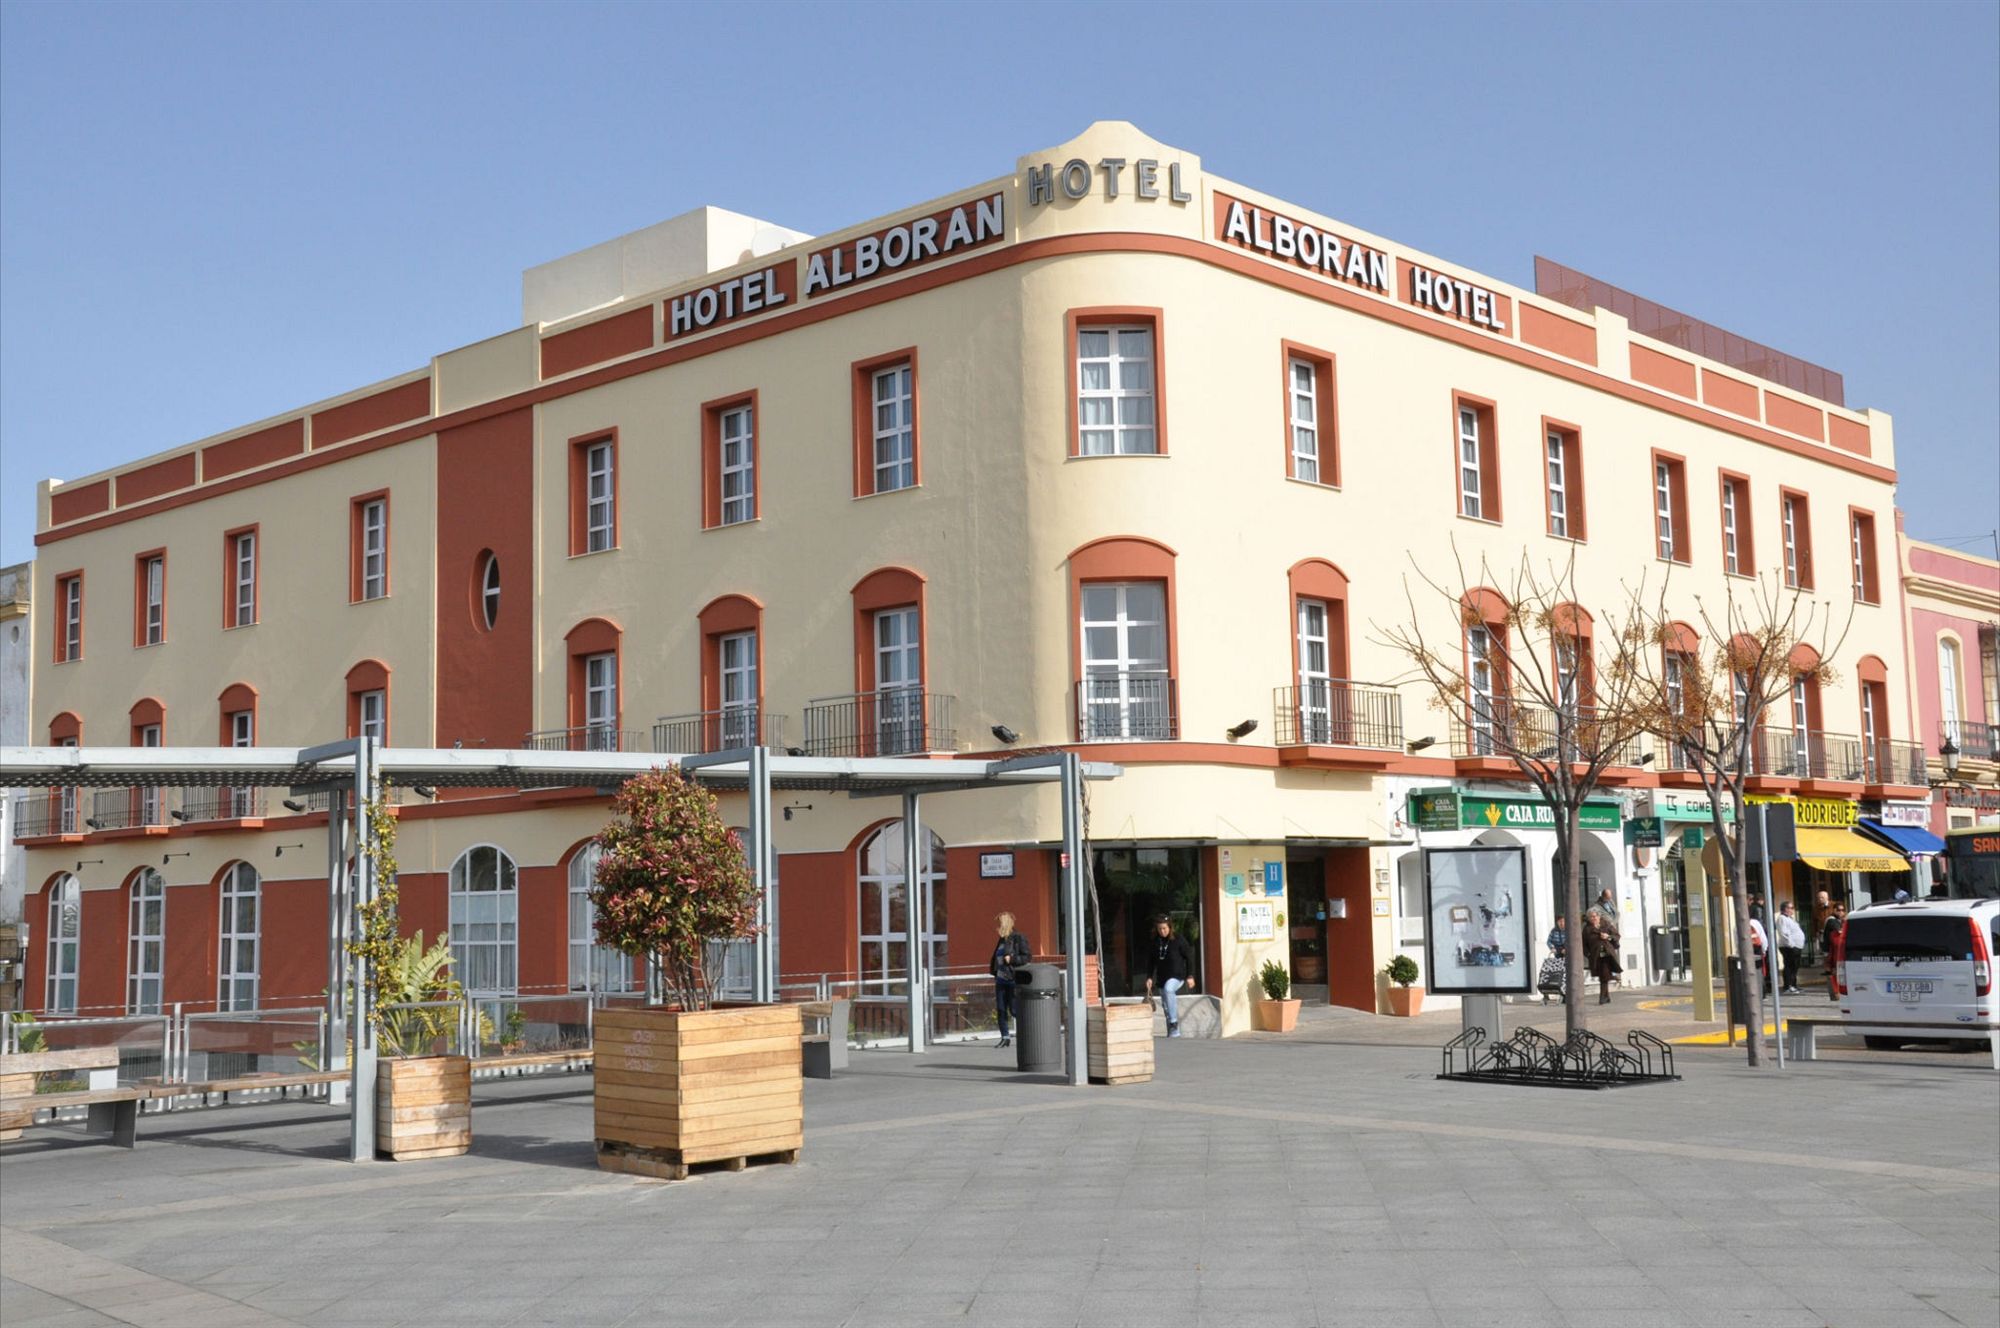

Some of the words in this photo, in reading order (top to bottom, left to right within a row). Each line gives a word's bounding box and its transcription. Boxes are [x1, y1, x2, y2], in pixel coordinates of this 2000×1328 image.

[1028, 158, 1192, 206] HOTEL
[671, 268, 785, 335] HOTEL
[805, 195, 1004, 294] ALBORAN
[1226, 201, 1389, 290] ALBORAN
[1412, 266, 1505, 330] HOTEL
[1505, 805, 1534, 823] CAJA
[1686, 800, 1731, 813] COMESA
[1797, 803, 1858, 824] RODRIGUEZ
[1270, 864, 1278, 881] H
[1854, 859, 1891, 870] AUTOBUSES
[1902, 993, 1917, 1001] SP
